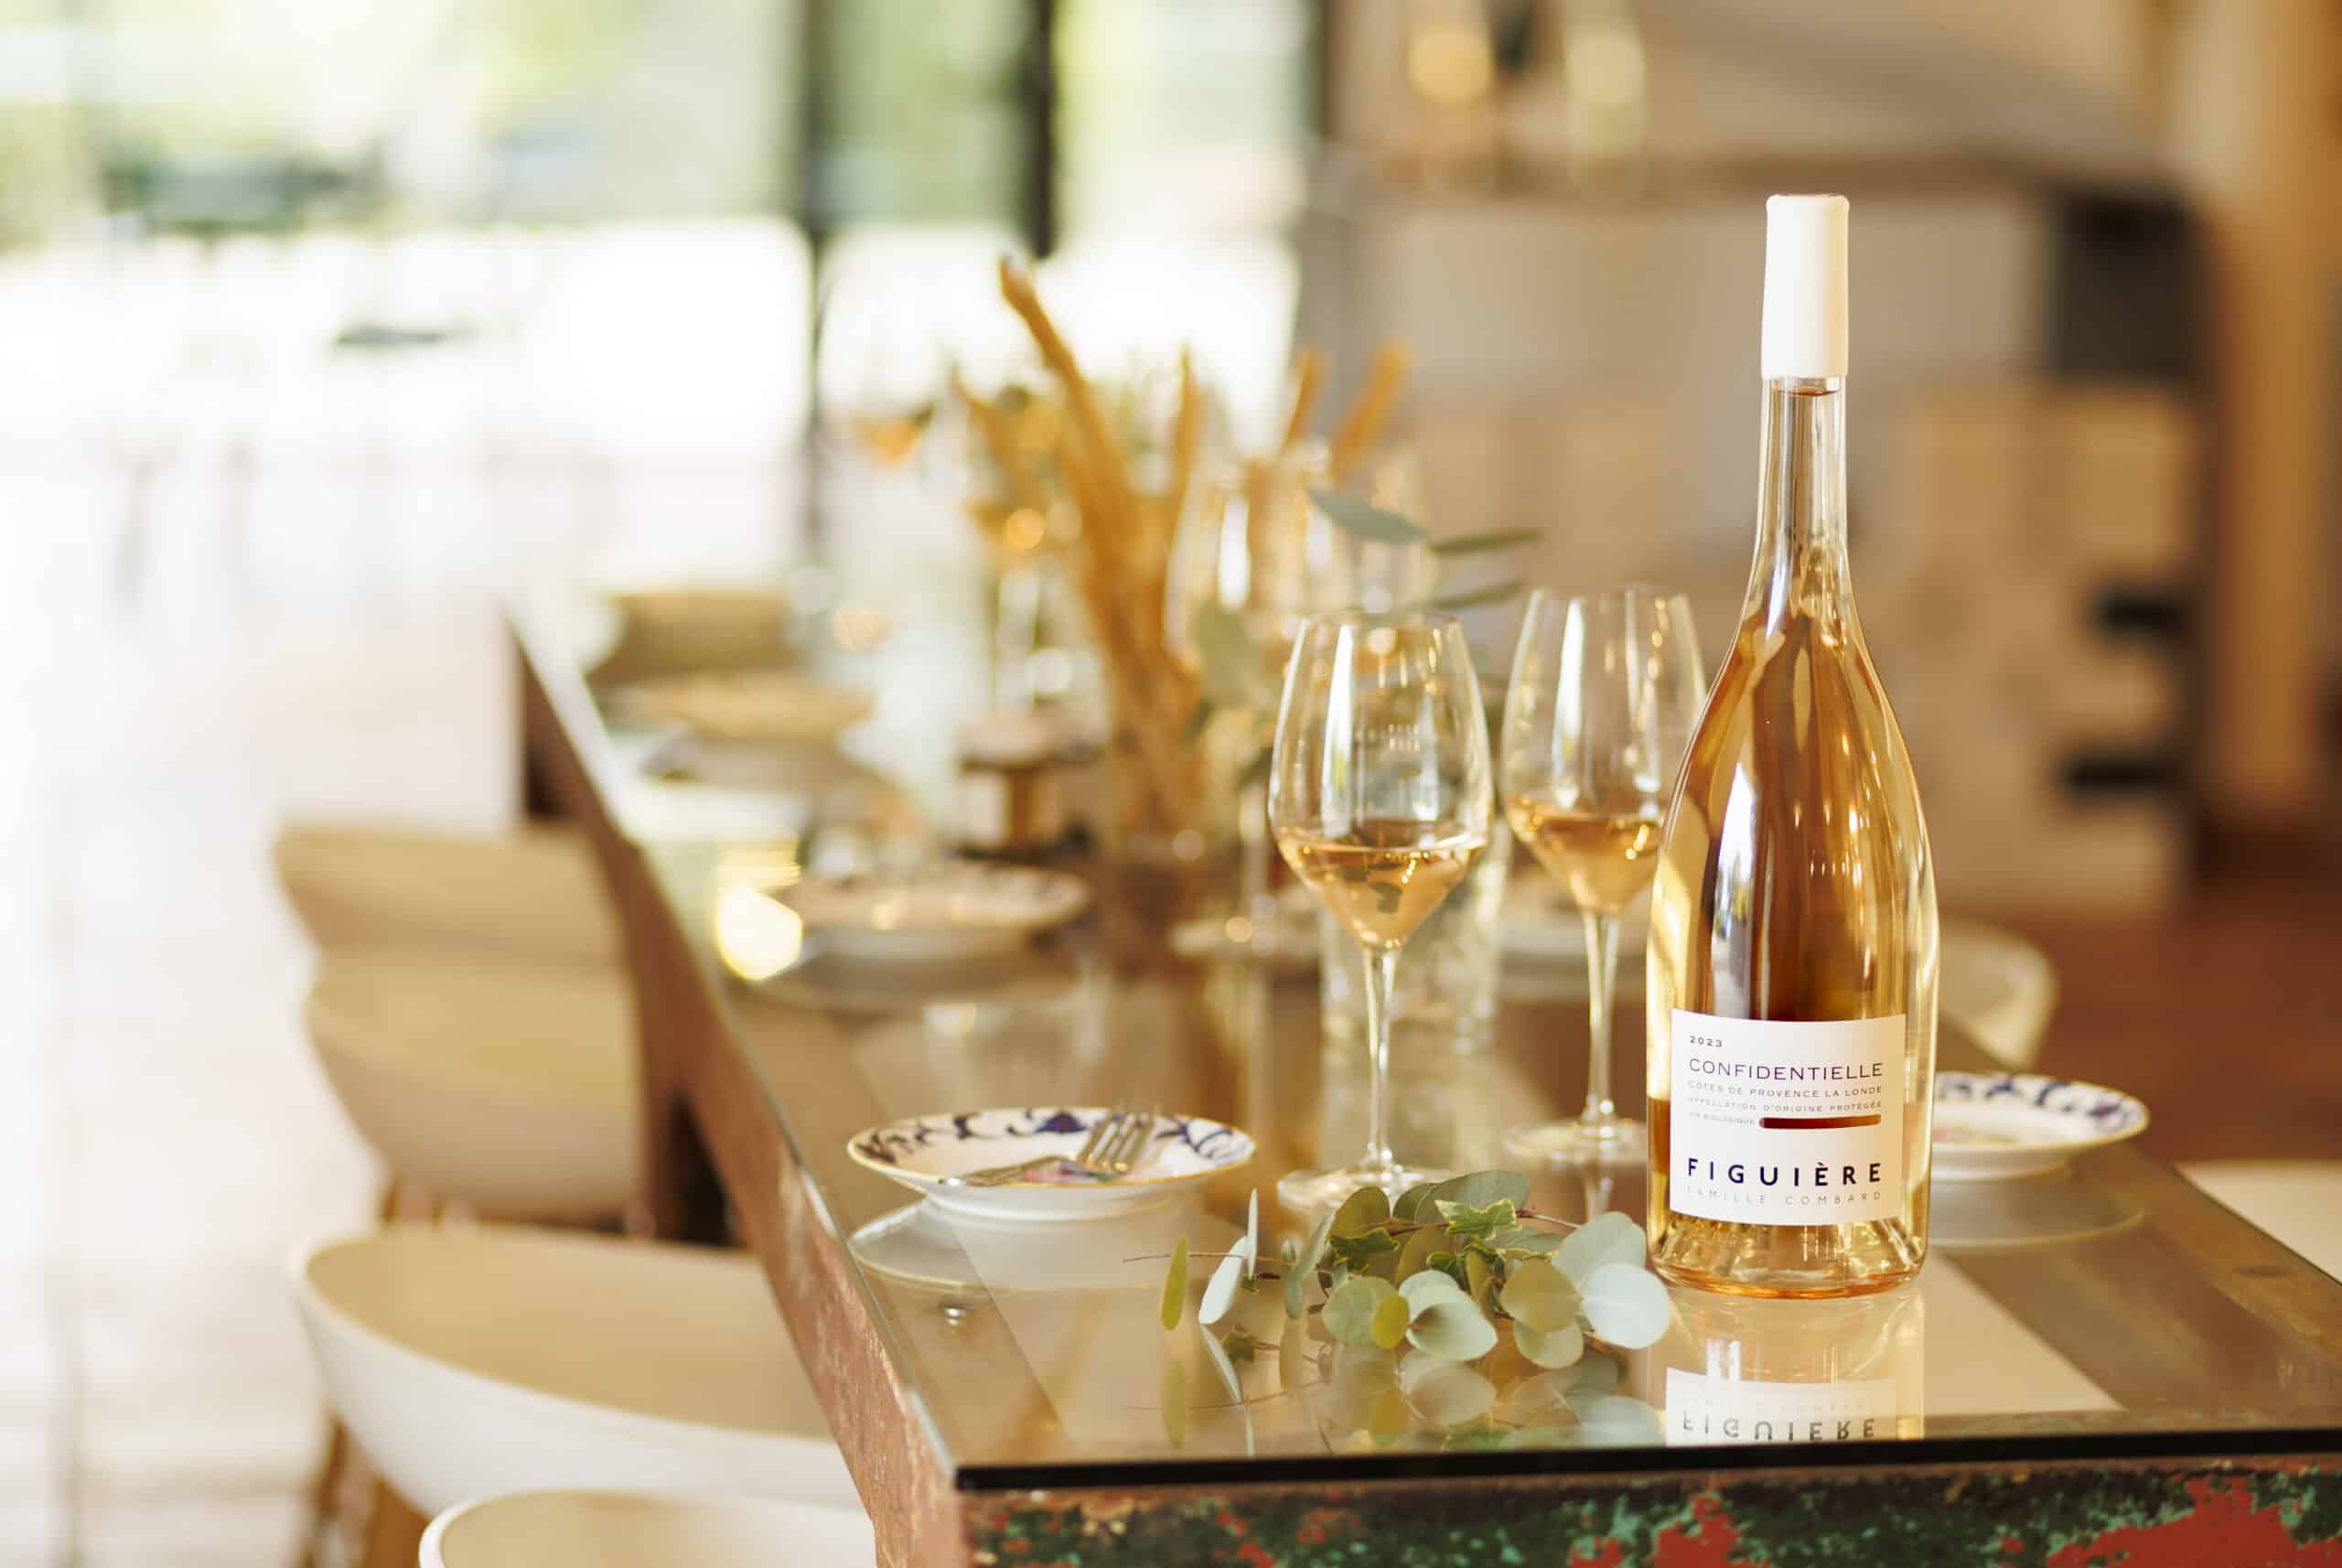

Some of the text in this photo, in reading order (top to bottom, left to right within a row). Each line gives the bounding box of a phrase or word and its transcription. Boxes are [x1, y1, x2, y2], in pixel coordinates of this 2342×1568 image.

[1690, 1036, 1723, 1047] 2023
[1689, 1058, 1883, 1080] CONFIDENTIELLE
[1729, 1087, 1743, 1095] DE
[1749, 1089, 1819, 1098] PROVENCE
[1844, 1086, 1882, 1097] LONDE
[1688, 1157, 1881, 1187] FIGUIÈRE
[1785, 1191, 1881, 1206] COMBARD
